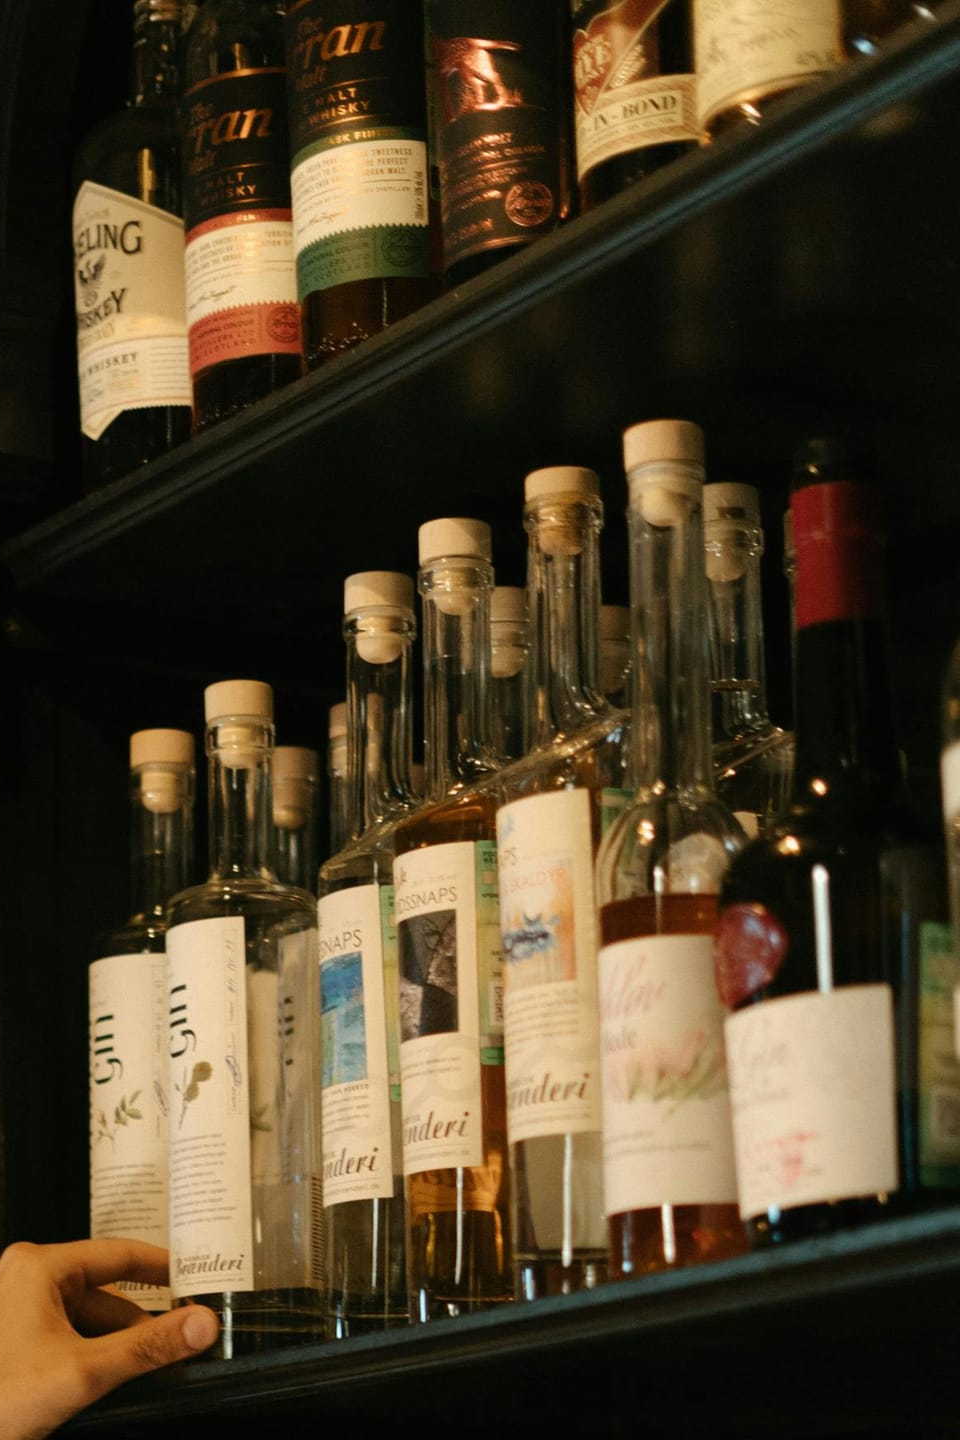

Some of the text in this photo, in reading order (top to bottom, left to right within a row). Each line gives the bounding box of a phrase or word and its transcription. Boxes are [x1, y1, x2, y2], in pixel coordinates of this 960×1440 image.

[327, 132, 351, 144] ASK
[95, 1013, 124, 1086] Gin
[169, 983, 198, 1059] Gin
